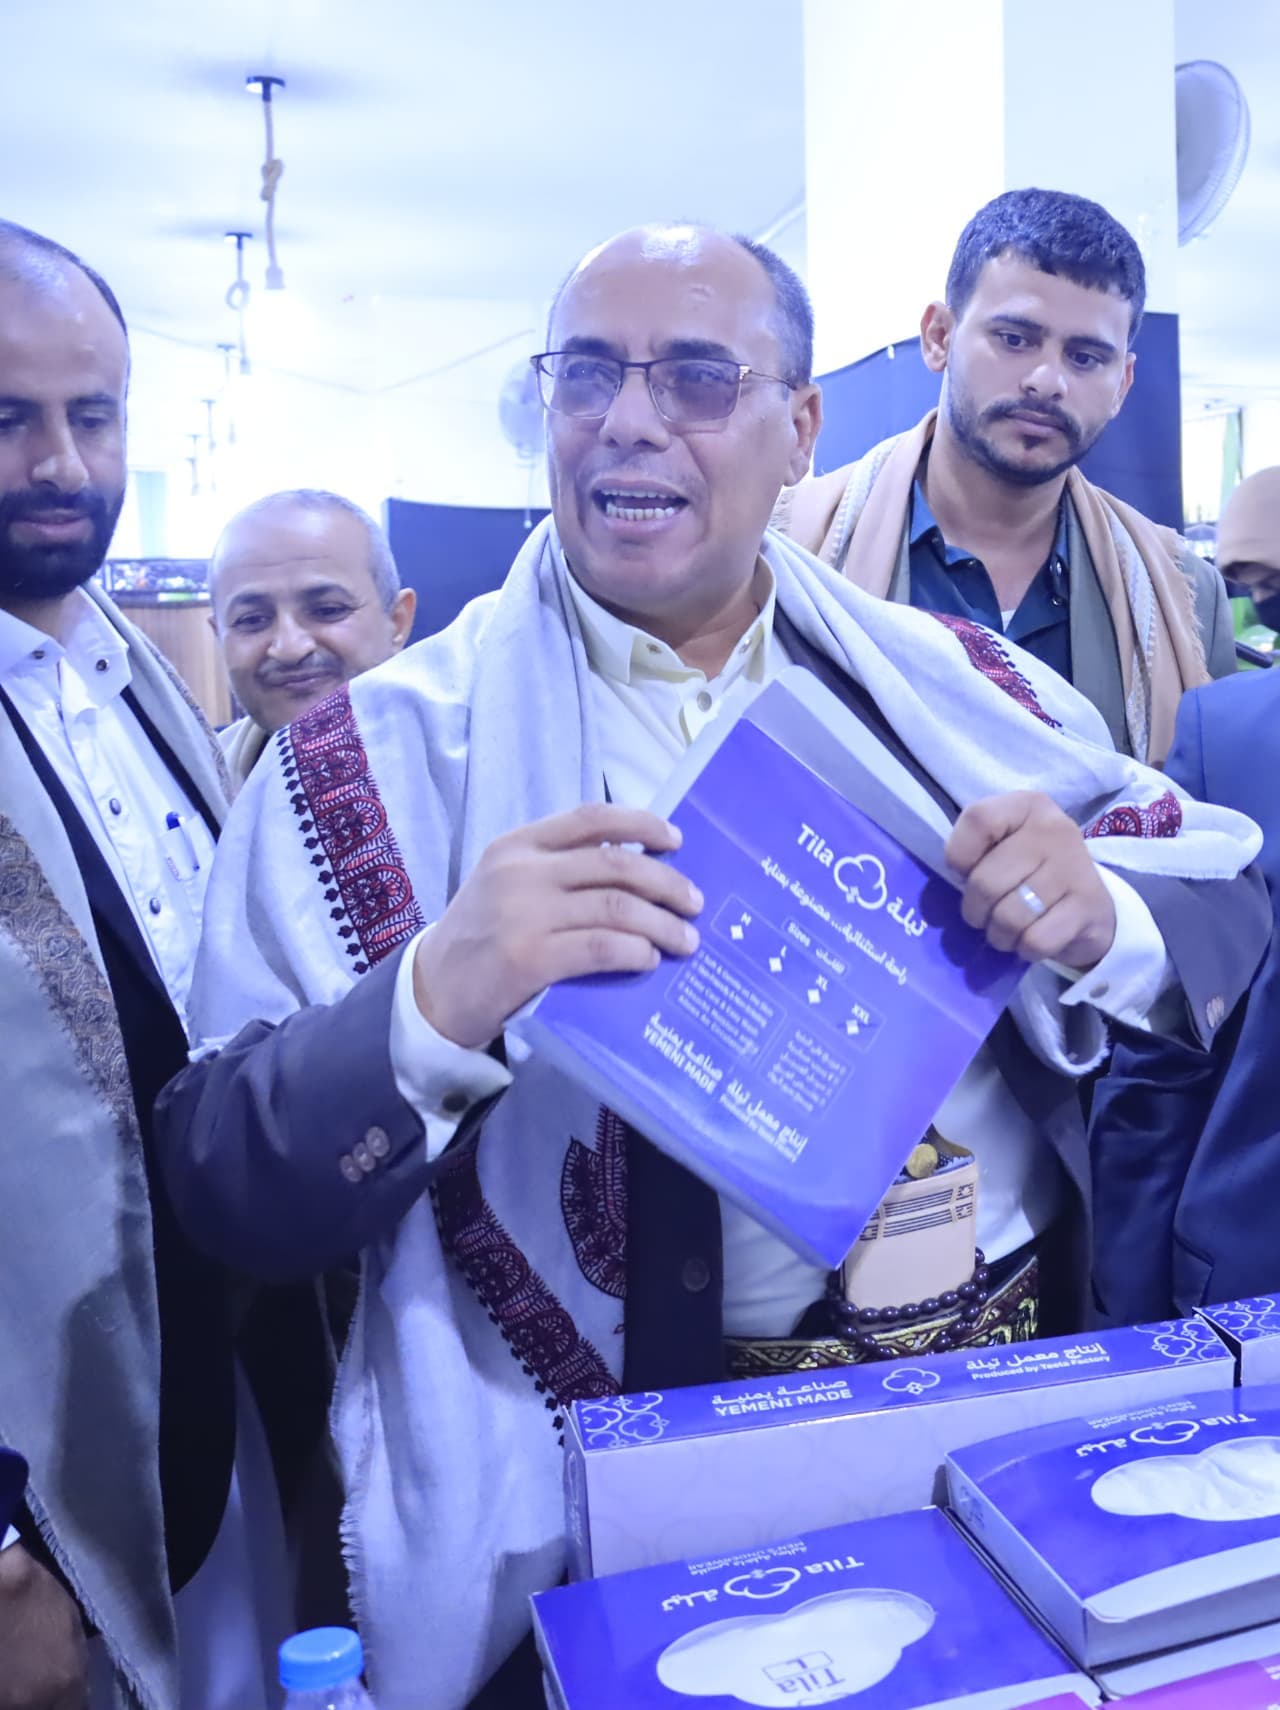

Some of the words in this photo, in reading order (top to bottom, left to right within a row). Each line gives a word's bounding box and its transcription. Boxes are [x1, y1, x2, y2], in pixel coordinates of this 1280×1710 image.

[797, 823, 833, 866] Tila
[760, 856, 789, 887] بعناية
[789, 881, 830, 921] مصنوعة
[740, 912, 751, 925] M
[886, 897, 927, 936] تيلة
[787, 922, 810, 946] Sizes
[780, 945, 786, 957] L
[815, 974, 827, 991] XL
[884, 957, 906, 984] راحة
[851, 1004, 869, 1023] XXL
[649, 1012, 683, 1049] يمنية
[644, 1025, 684, 1066] YEMENI
[684, 1061, 715, 1092] MADE
[683, 1041, 722, 1081] صناعة
[727, 1079, 750, 1104] تيلة
[746, 1100, 779, 1131] معمل
[777, 1125, 807, 1155] إنتاج
[1006, 1352, 1058, 1367] معمل
[1063, 1342, 1107, 1359] إنتاج
[966, 1358, 1000, 1370] تيلة
[972, 1368, 1024, 1380] Produced
[1025, 1366, 1039, 1374] by
[1071, 1355, 1110, 1366] Factory
[712, 1391, 774, 1405] يمنية
[777, 1380, 848, 1396] صناعة
[715, 1399, 793, 1417] YEMENI
[794, 1388, 853, 1406] MADE
[1200, 1414, 1256, 1425] Tila
[1076, 1438, 1127, 1457] تيلة
[804, 1556, 864, 1574] Tila
[662, 1589, 718, 1611] تيلة
[776, 1668, 846, 1692] Tila
